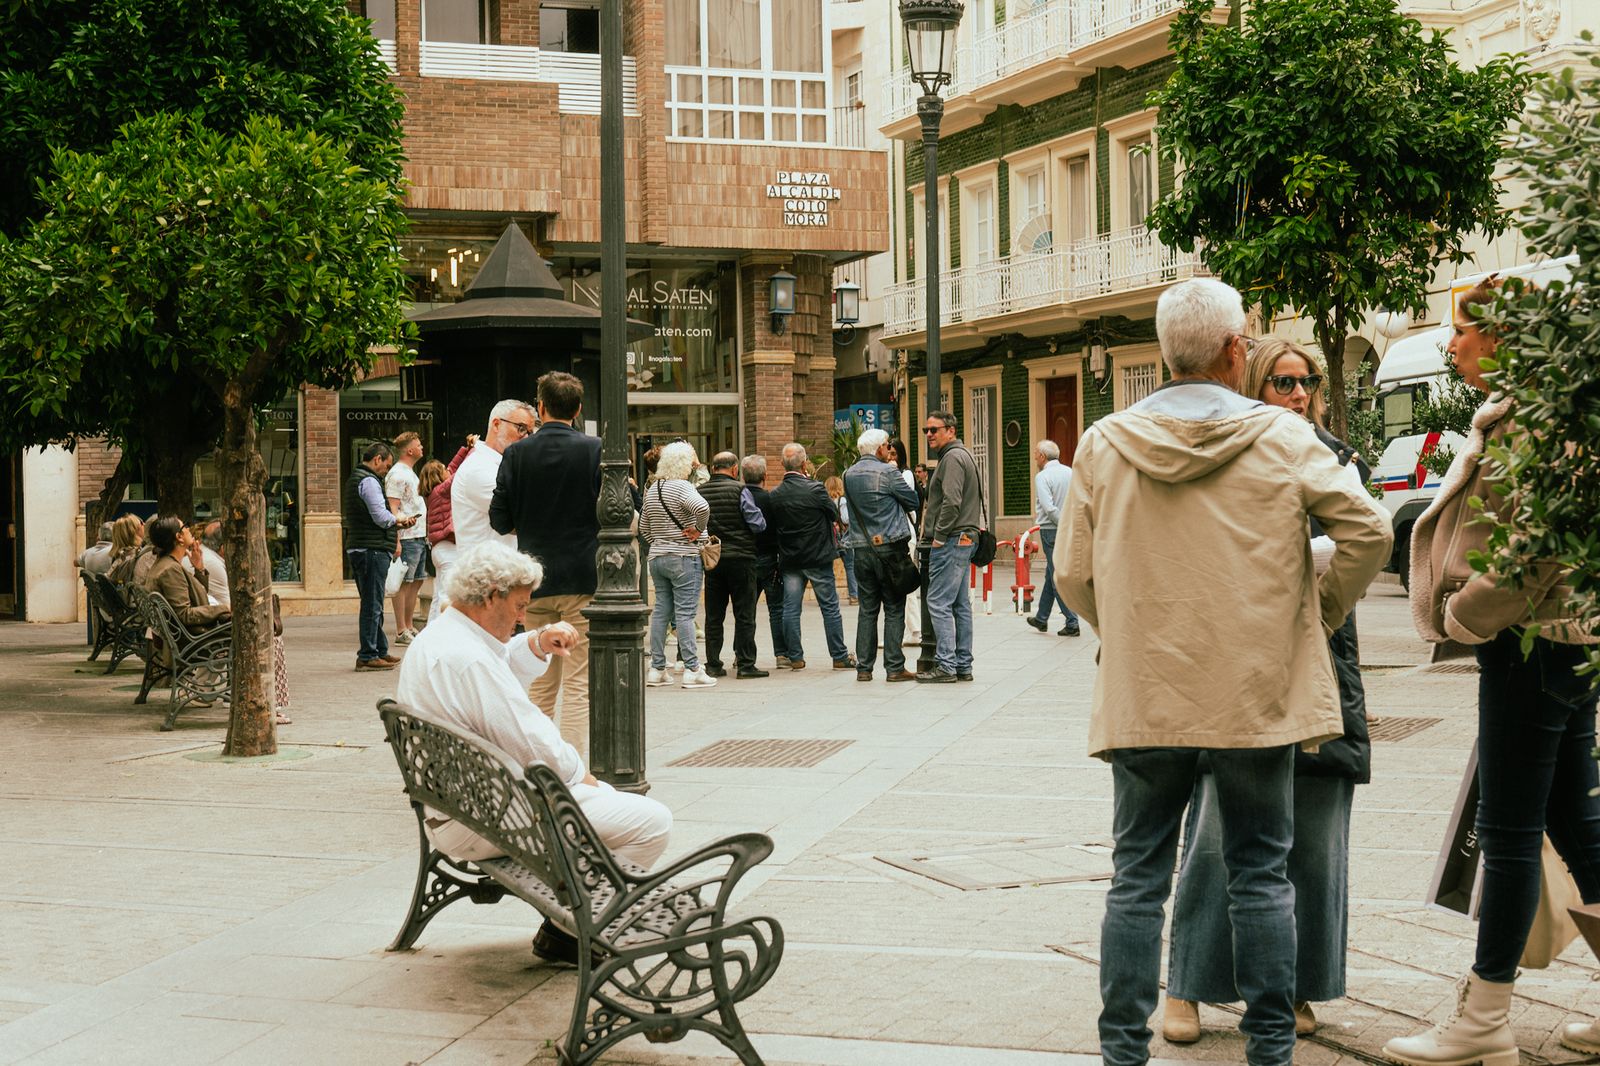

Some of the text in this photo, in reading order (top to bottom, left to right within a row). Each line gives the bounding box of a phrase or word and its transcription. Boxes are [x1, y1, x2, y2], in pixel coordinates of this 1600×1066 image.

[779, 172, 828, 185] PLAZA
[769, 186, 839, 201] ALCALDE
[785, 200, 826, 212] COTO
[785, 213, 826, 226] MORA
[572, 279, 649, 307] NAL
[654, 327, 712, 337] aten.com
[346, 411, 433, 421] CORTINA TA
